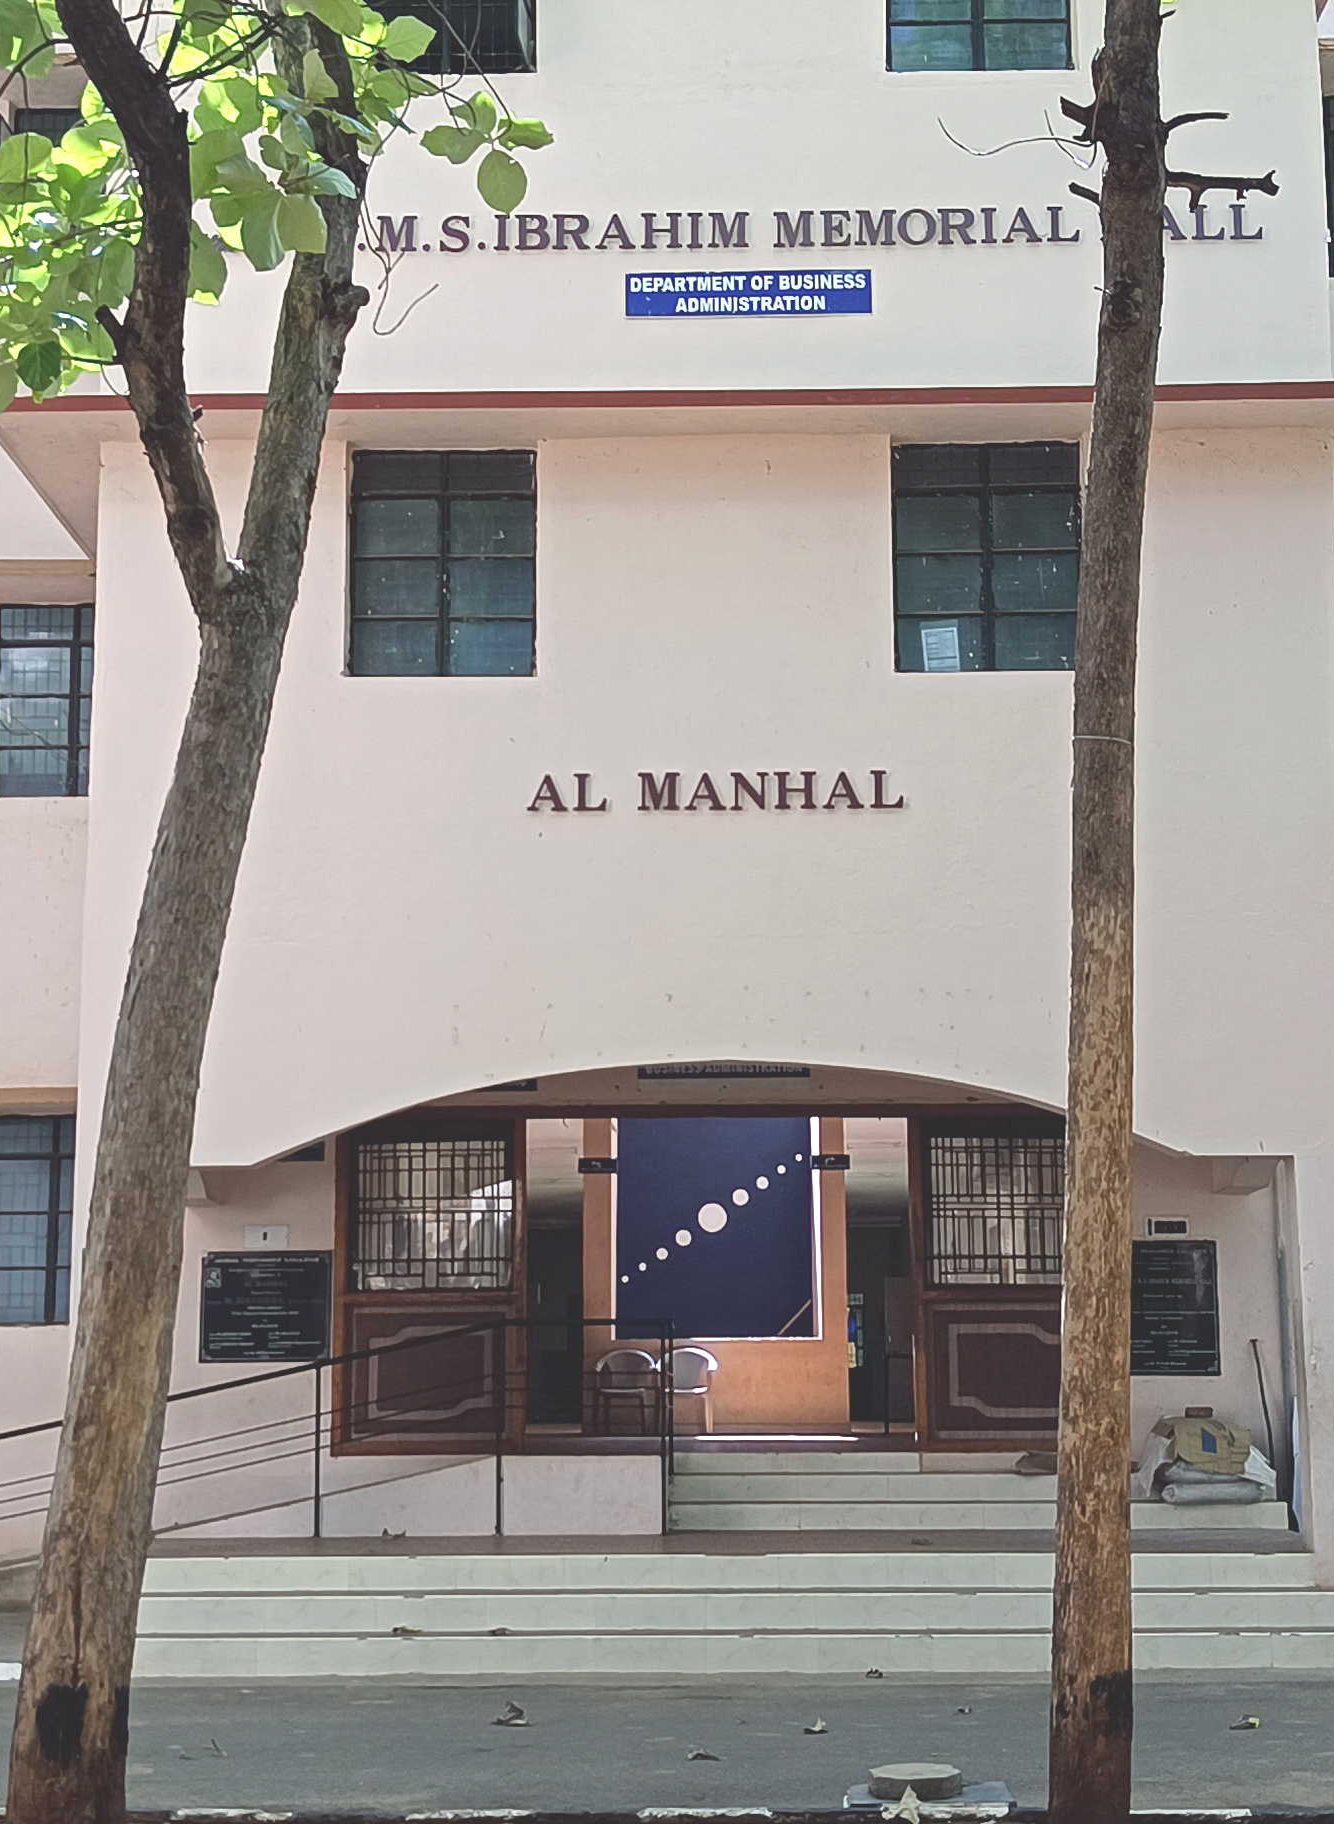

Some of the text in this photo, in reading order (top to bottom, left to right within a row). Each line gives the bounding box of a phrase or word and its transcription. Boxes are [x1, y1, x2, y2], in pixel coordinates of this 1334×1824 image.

[357, 203, 1264, 253] .M.S.IBRAHIM MEMORIAL ALL
[629, 273, 866, 293] DEPARTMENT OF BUSINESS
[675, 295, 826, 313] ADMINISTRATION
[526, 769, 904, 812] AL MANHAL
